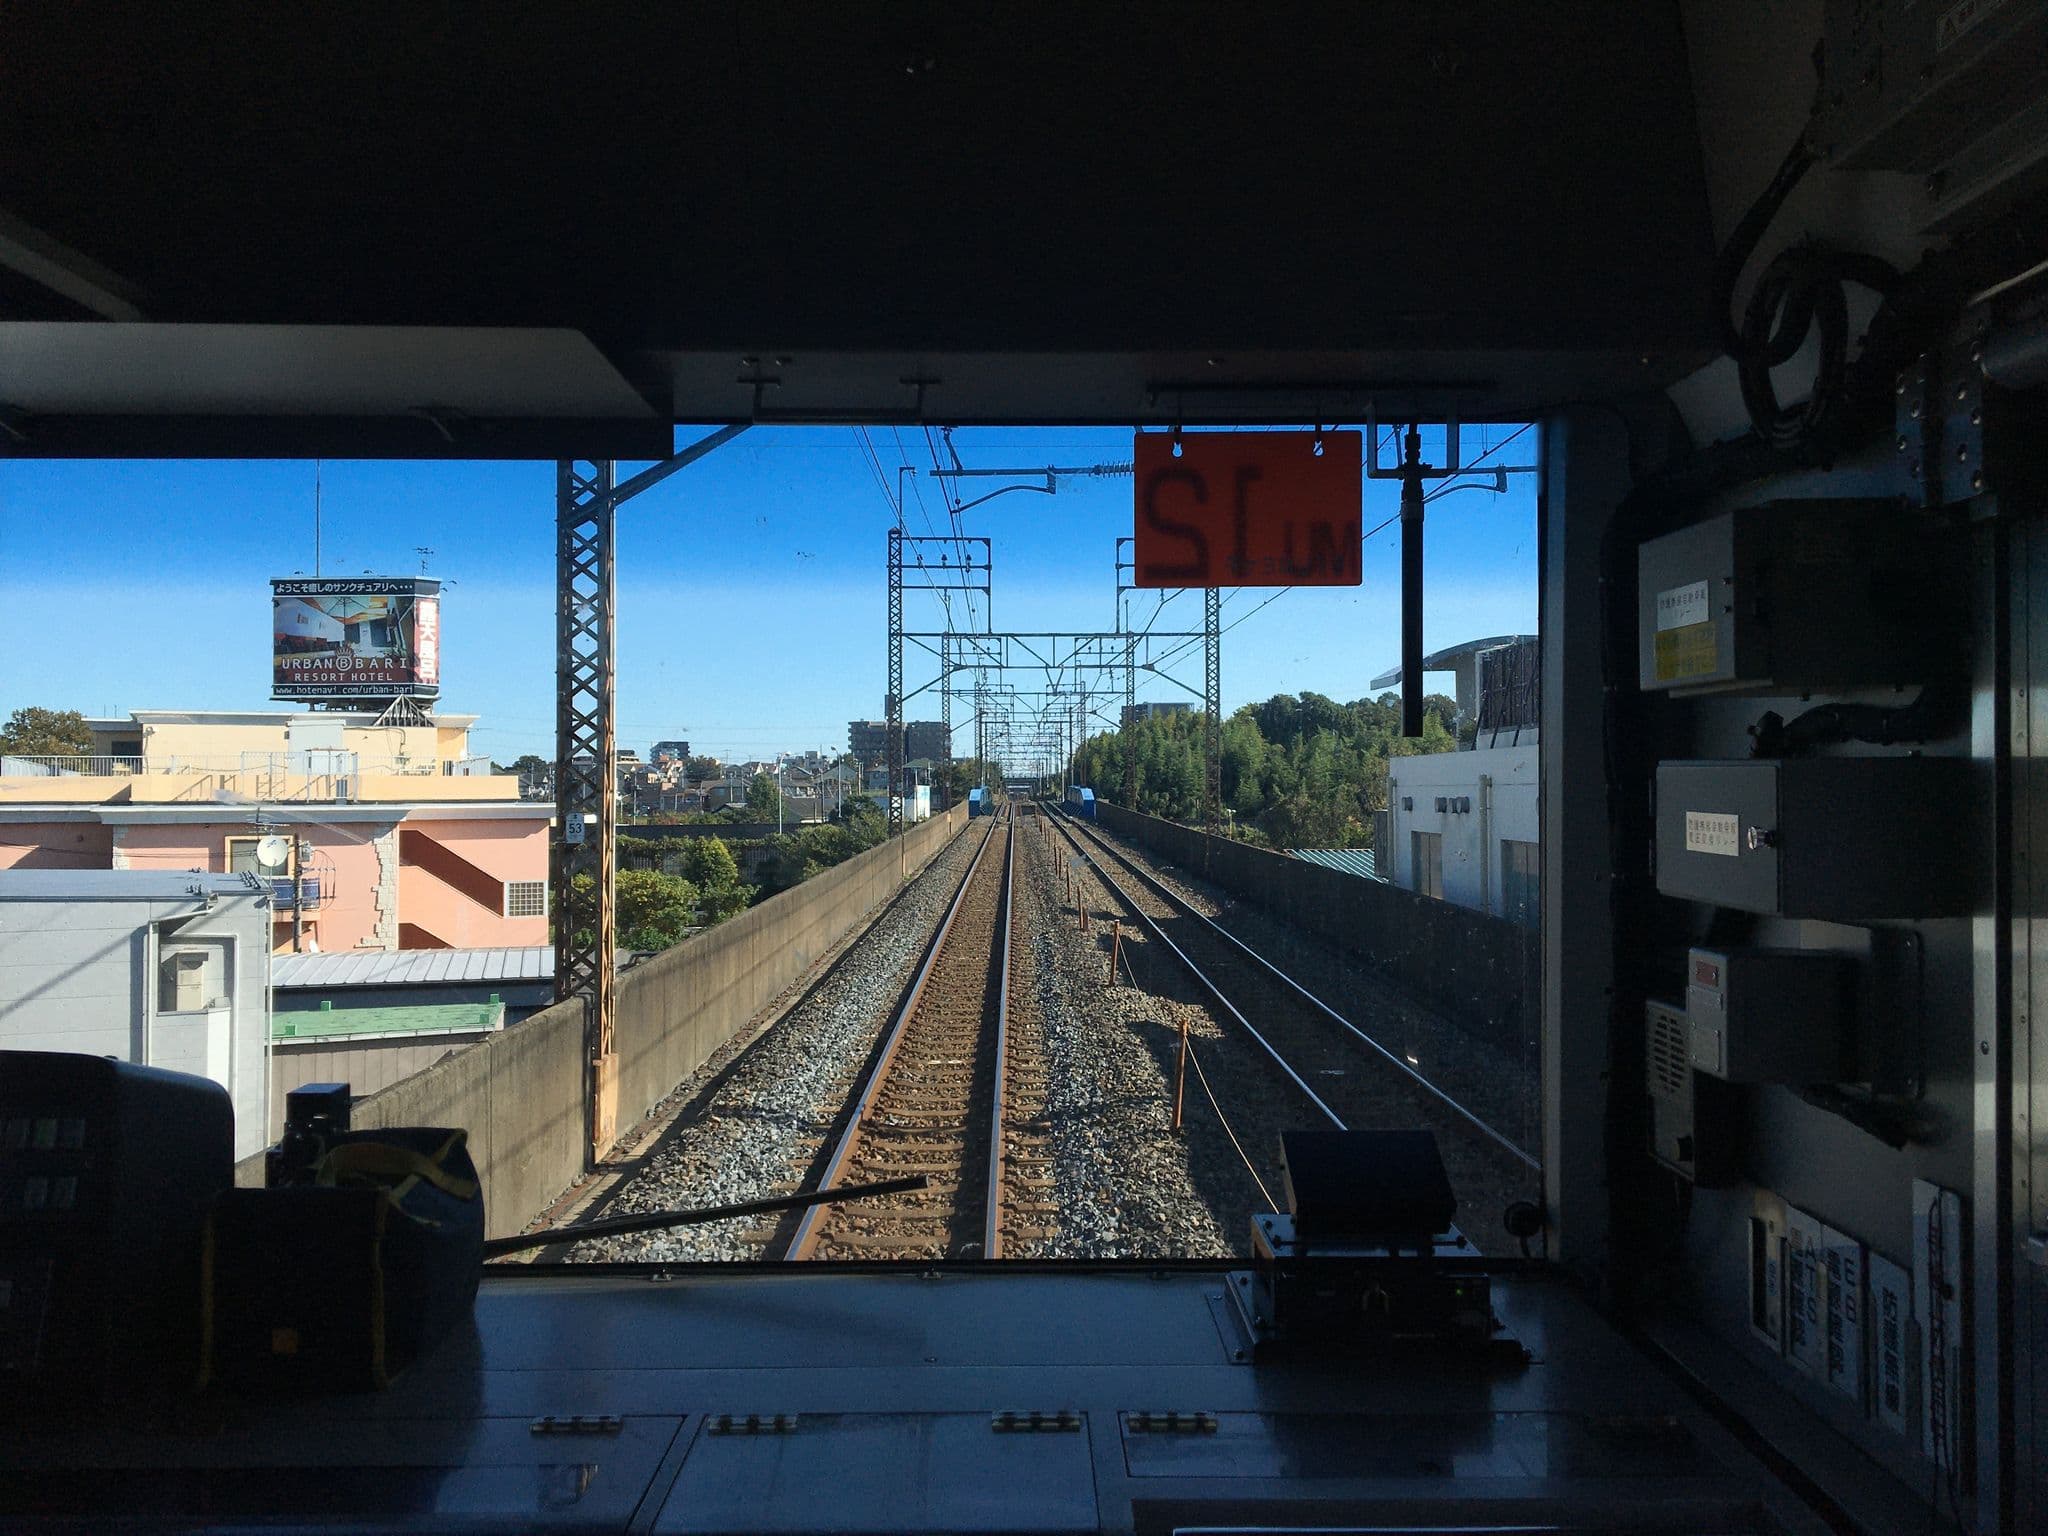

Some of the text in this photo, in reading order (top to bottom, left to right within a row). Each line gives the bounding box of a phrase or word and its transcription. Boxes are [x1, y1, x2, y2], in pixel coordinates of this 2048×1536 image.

[281, 658, 333, 669] URBAN
[355, 658, 407, 669] BARI
[294, 672, 393, 682] RESORT HOTEL
[569, 822, 582, 834] 53
